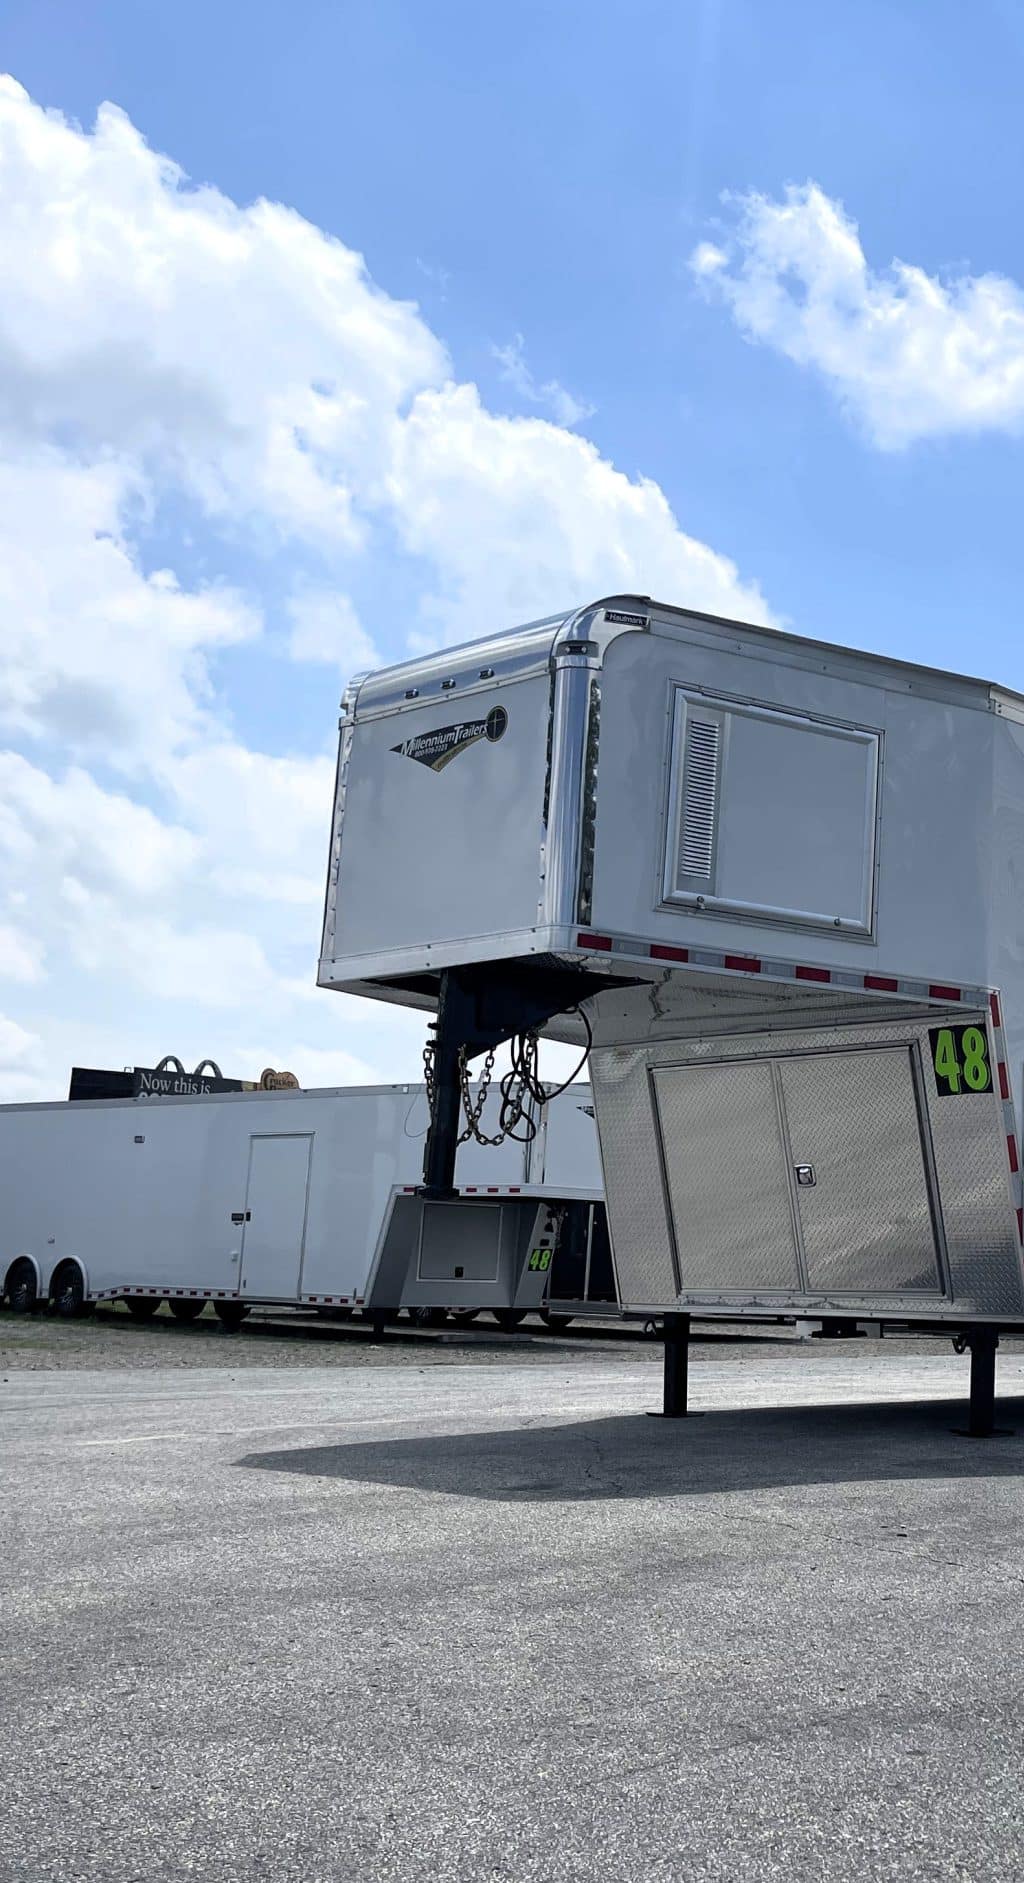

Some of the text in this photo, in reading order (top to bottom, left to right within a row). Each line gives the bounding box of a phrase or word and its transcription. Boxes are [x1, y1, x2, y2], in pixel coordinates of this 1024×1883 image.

[609, 612, 644, 625] Haulmark
[935, 1026, 991, 1093] 48
[140, 1073, 211, 1095] Now this is
[530, 1249, 551, 1271] 48
